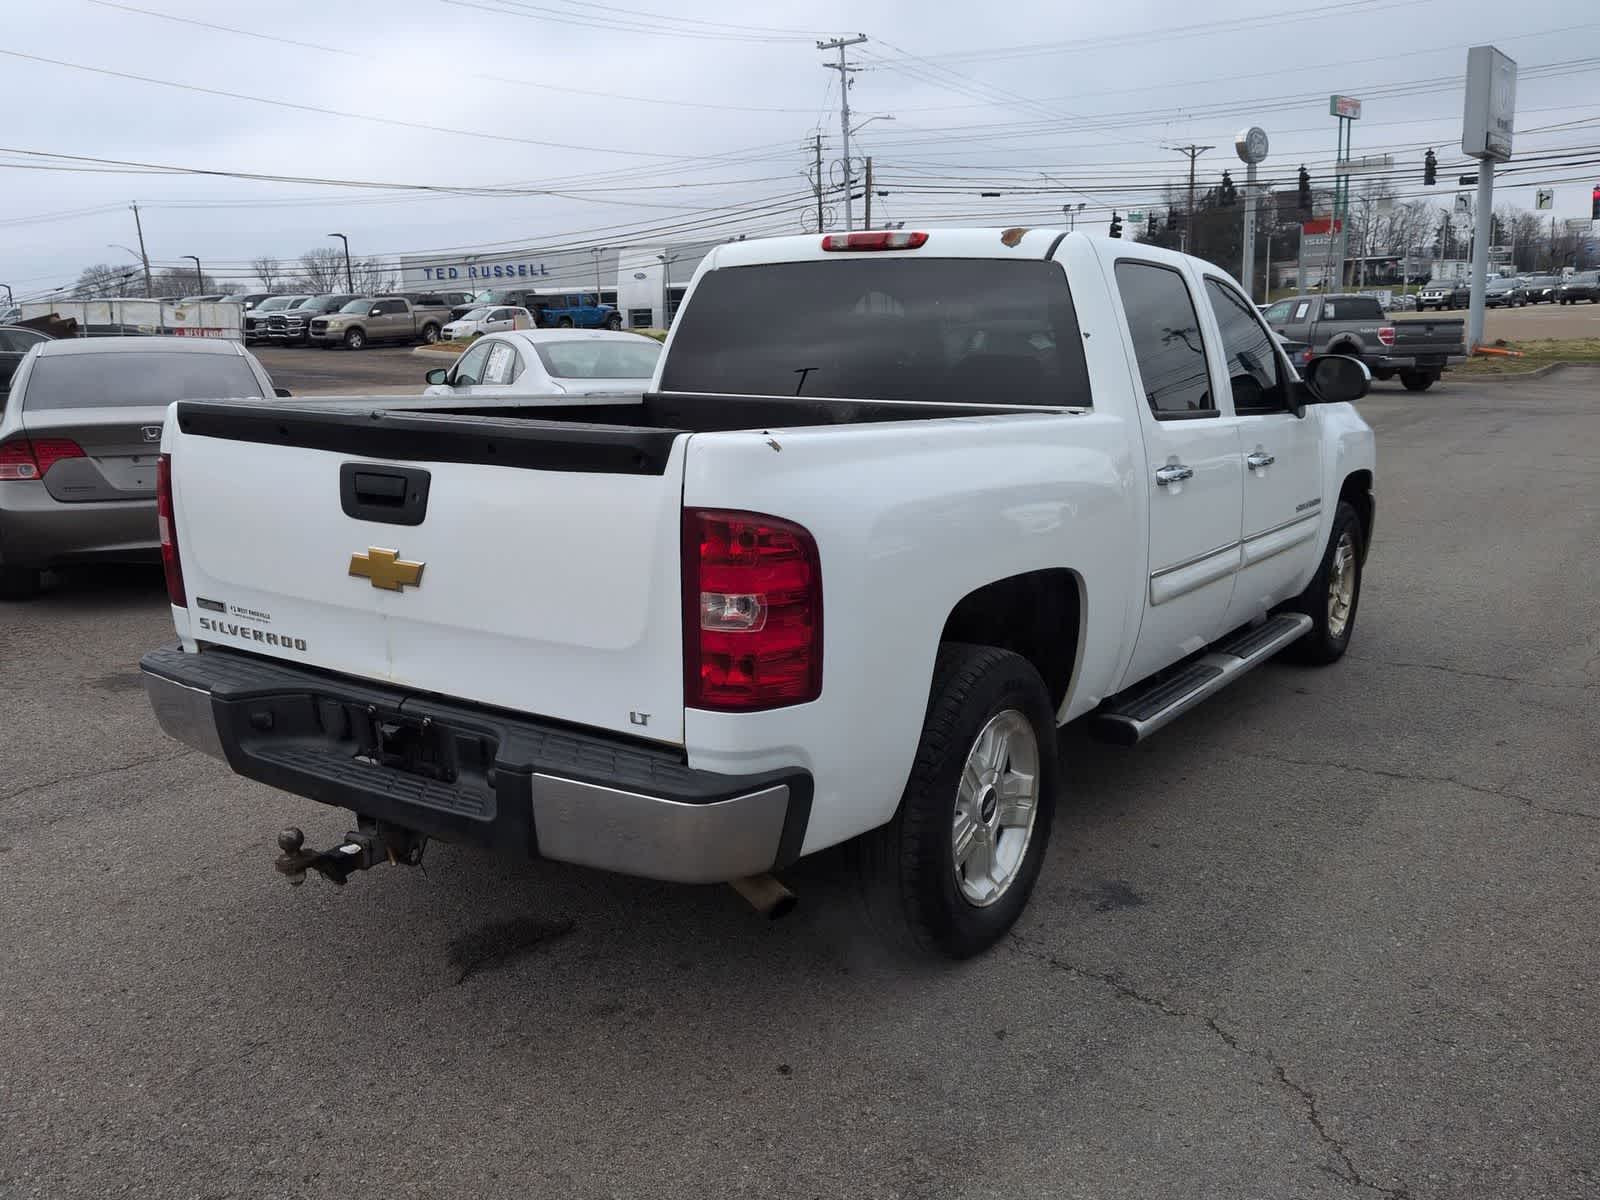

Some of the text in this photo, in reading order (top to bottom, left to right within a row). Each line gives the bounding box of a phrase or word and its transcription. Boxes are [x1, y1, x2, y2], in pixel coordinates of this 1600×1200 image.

[424, 263, 549, 281] TED RUSSELL
[199, 617, 307, 652] SILVERADO
[629, 711, 651, 726] LT
